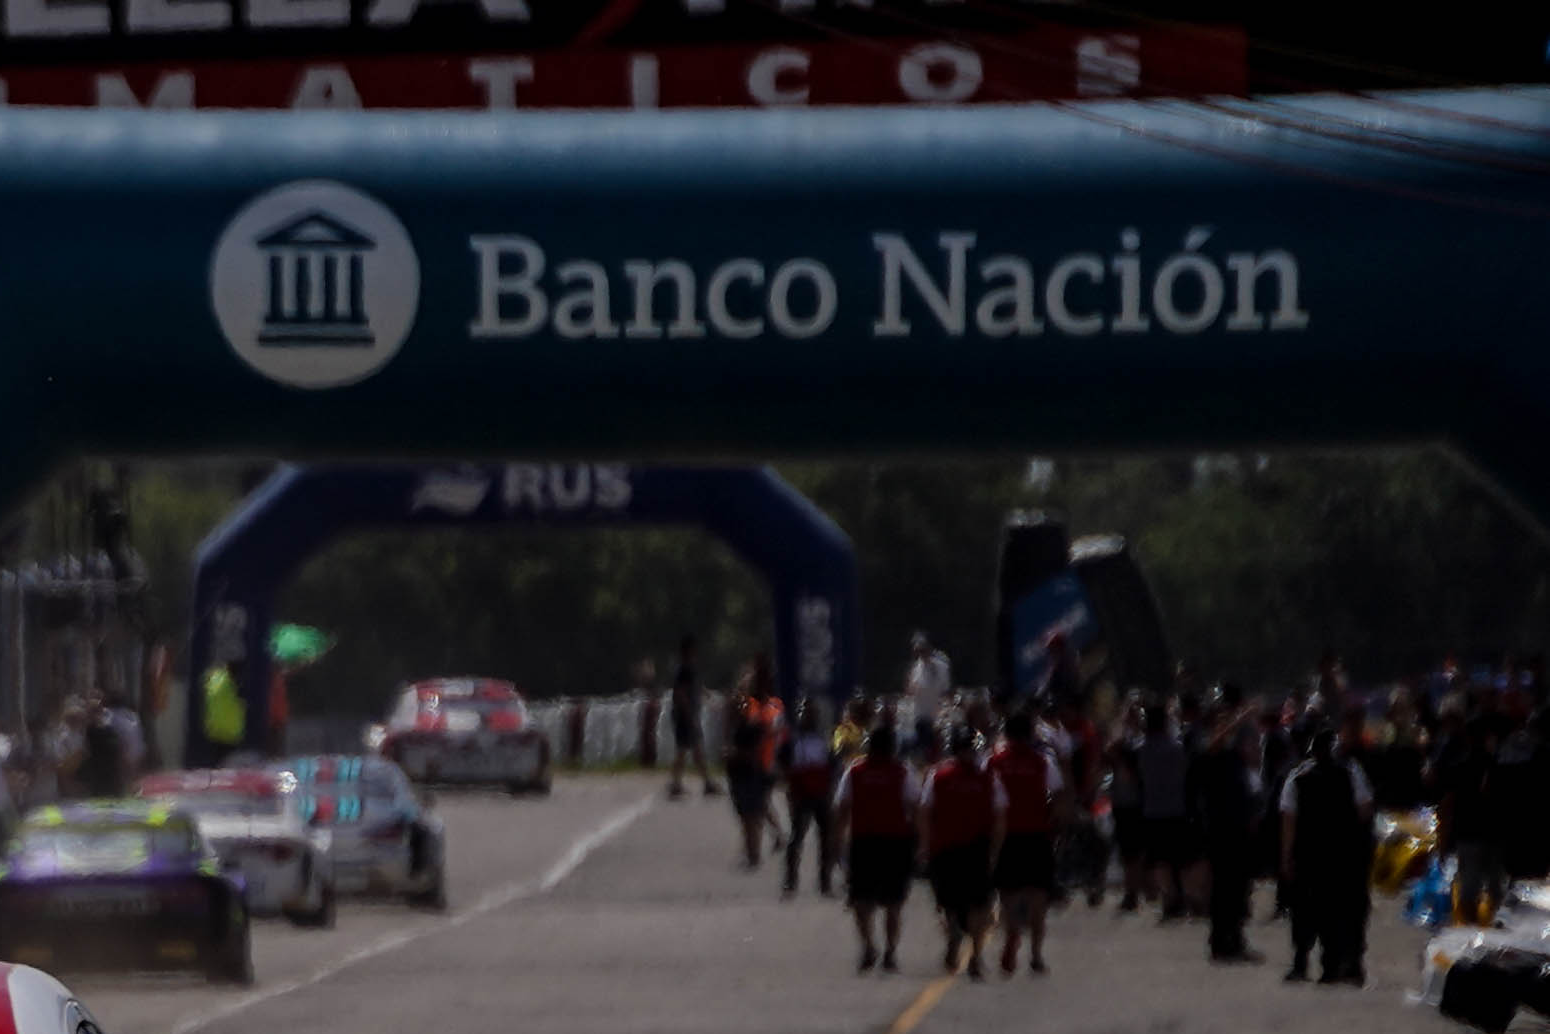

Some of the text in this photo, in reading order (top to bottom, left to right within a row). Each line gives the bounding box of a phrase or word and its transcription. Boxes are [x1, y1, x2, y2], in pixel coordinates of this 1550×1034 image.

[468, 225, 1312, 341] Banco Nación
[503, 459, 633, 511] RUS
